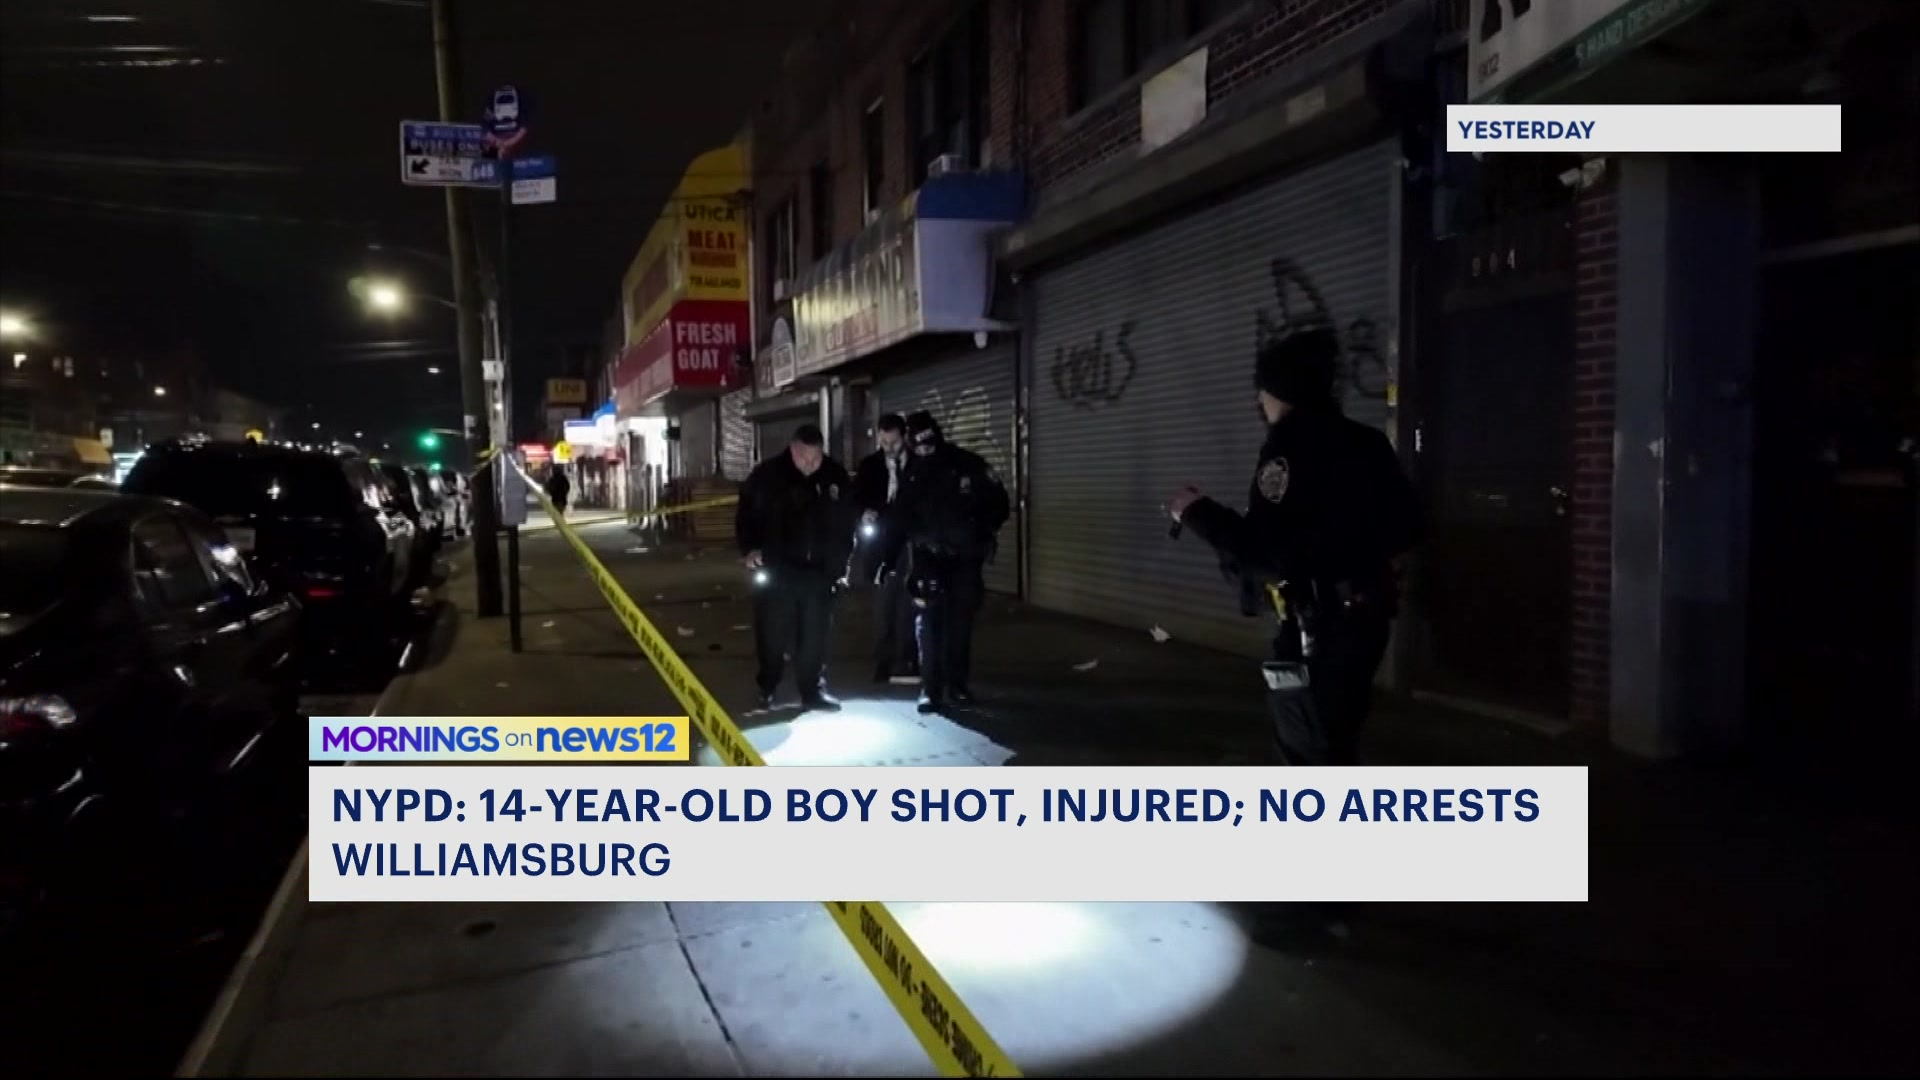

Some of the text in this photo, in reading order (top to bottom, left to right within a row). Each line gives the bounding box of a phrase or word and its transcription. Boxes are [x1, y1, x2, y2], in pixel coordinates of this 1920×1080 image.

[684, 204, 736, 223] UTICA
[687, 229, 737, 250] MEAT
[675, 320, 737, 345] FRESH
[677, 347, 721, 371] GOAT
